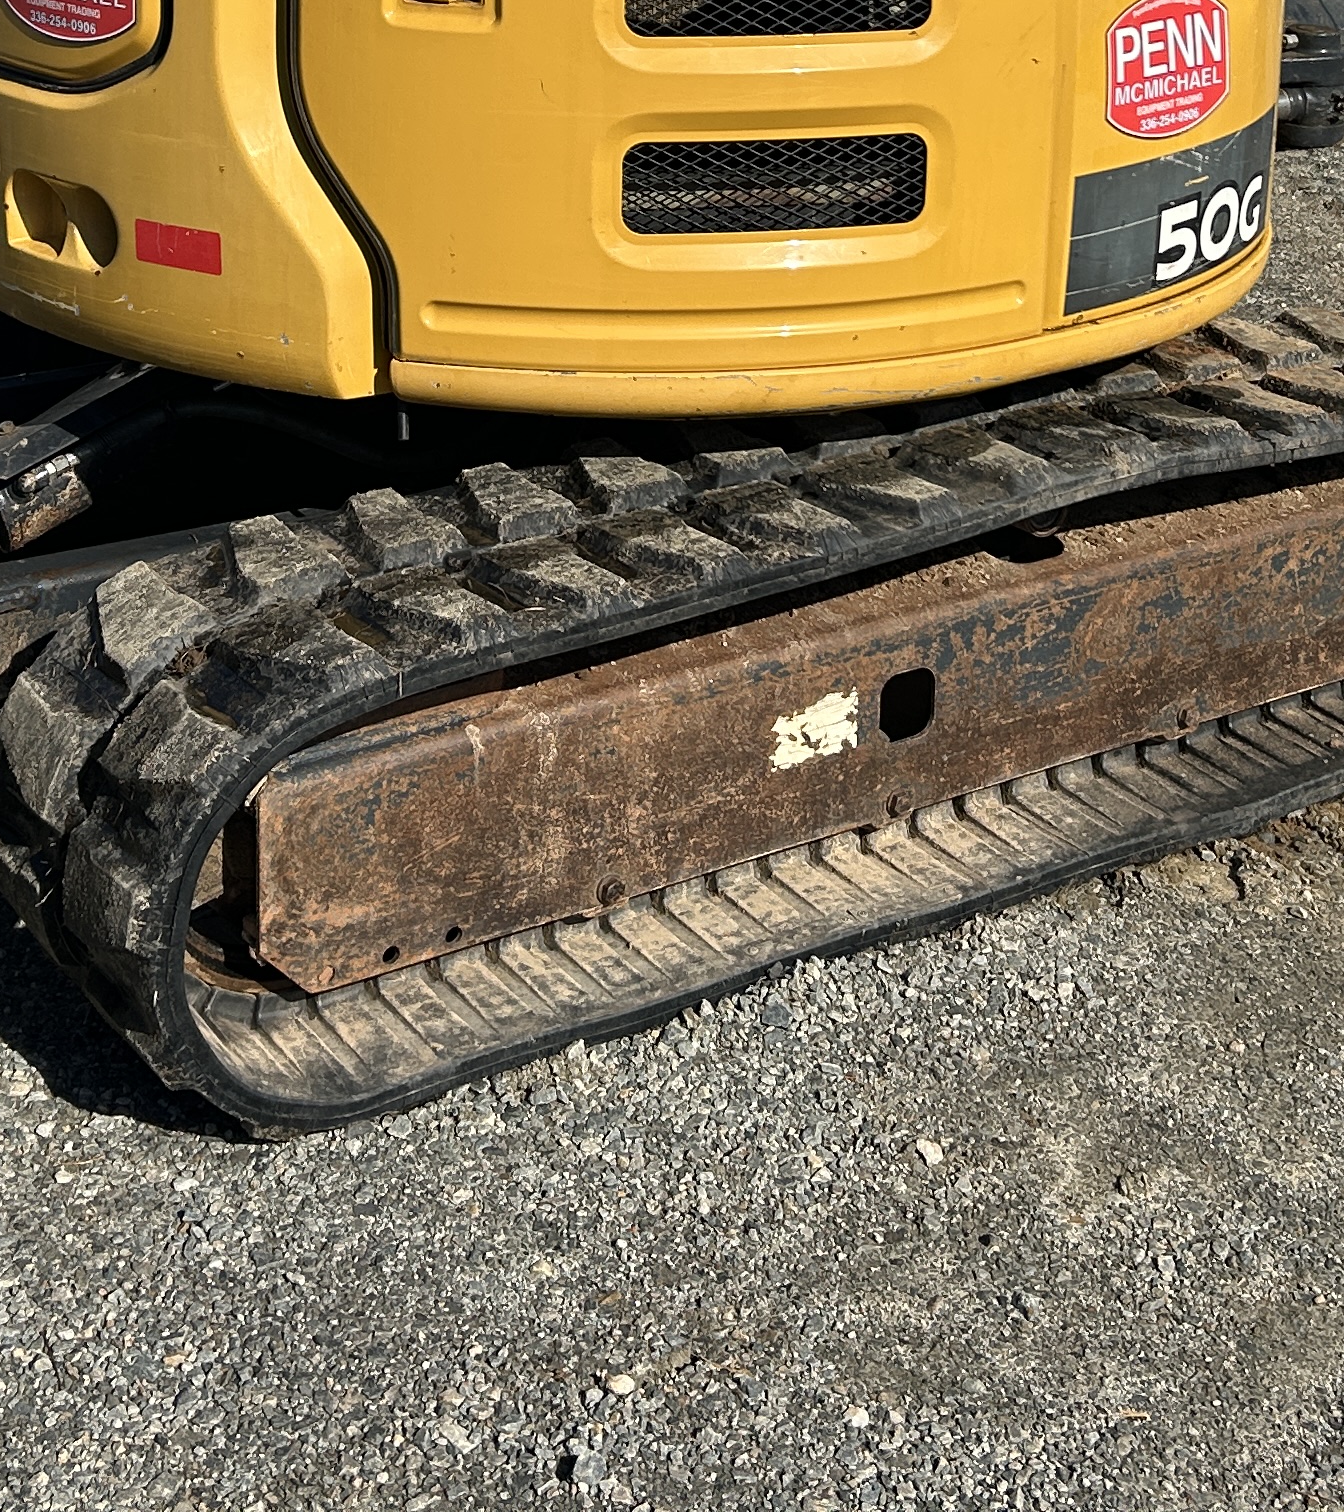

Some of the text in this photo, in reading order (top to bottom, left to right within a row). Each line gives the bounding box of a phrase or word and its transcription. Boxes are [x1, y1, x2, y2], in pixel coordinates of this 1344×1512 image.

[29, 9, 97, 35] 336-254-0906
[66, 3, 101, 19] TRADING
[1115, 8, 1223, 84] PENN
[1114, 65, 1223, 107] MCMICHAEL
[1156, 174, 1263, 281] 50G
